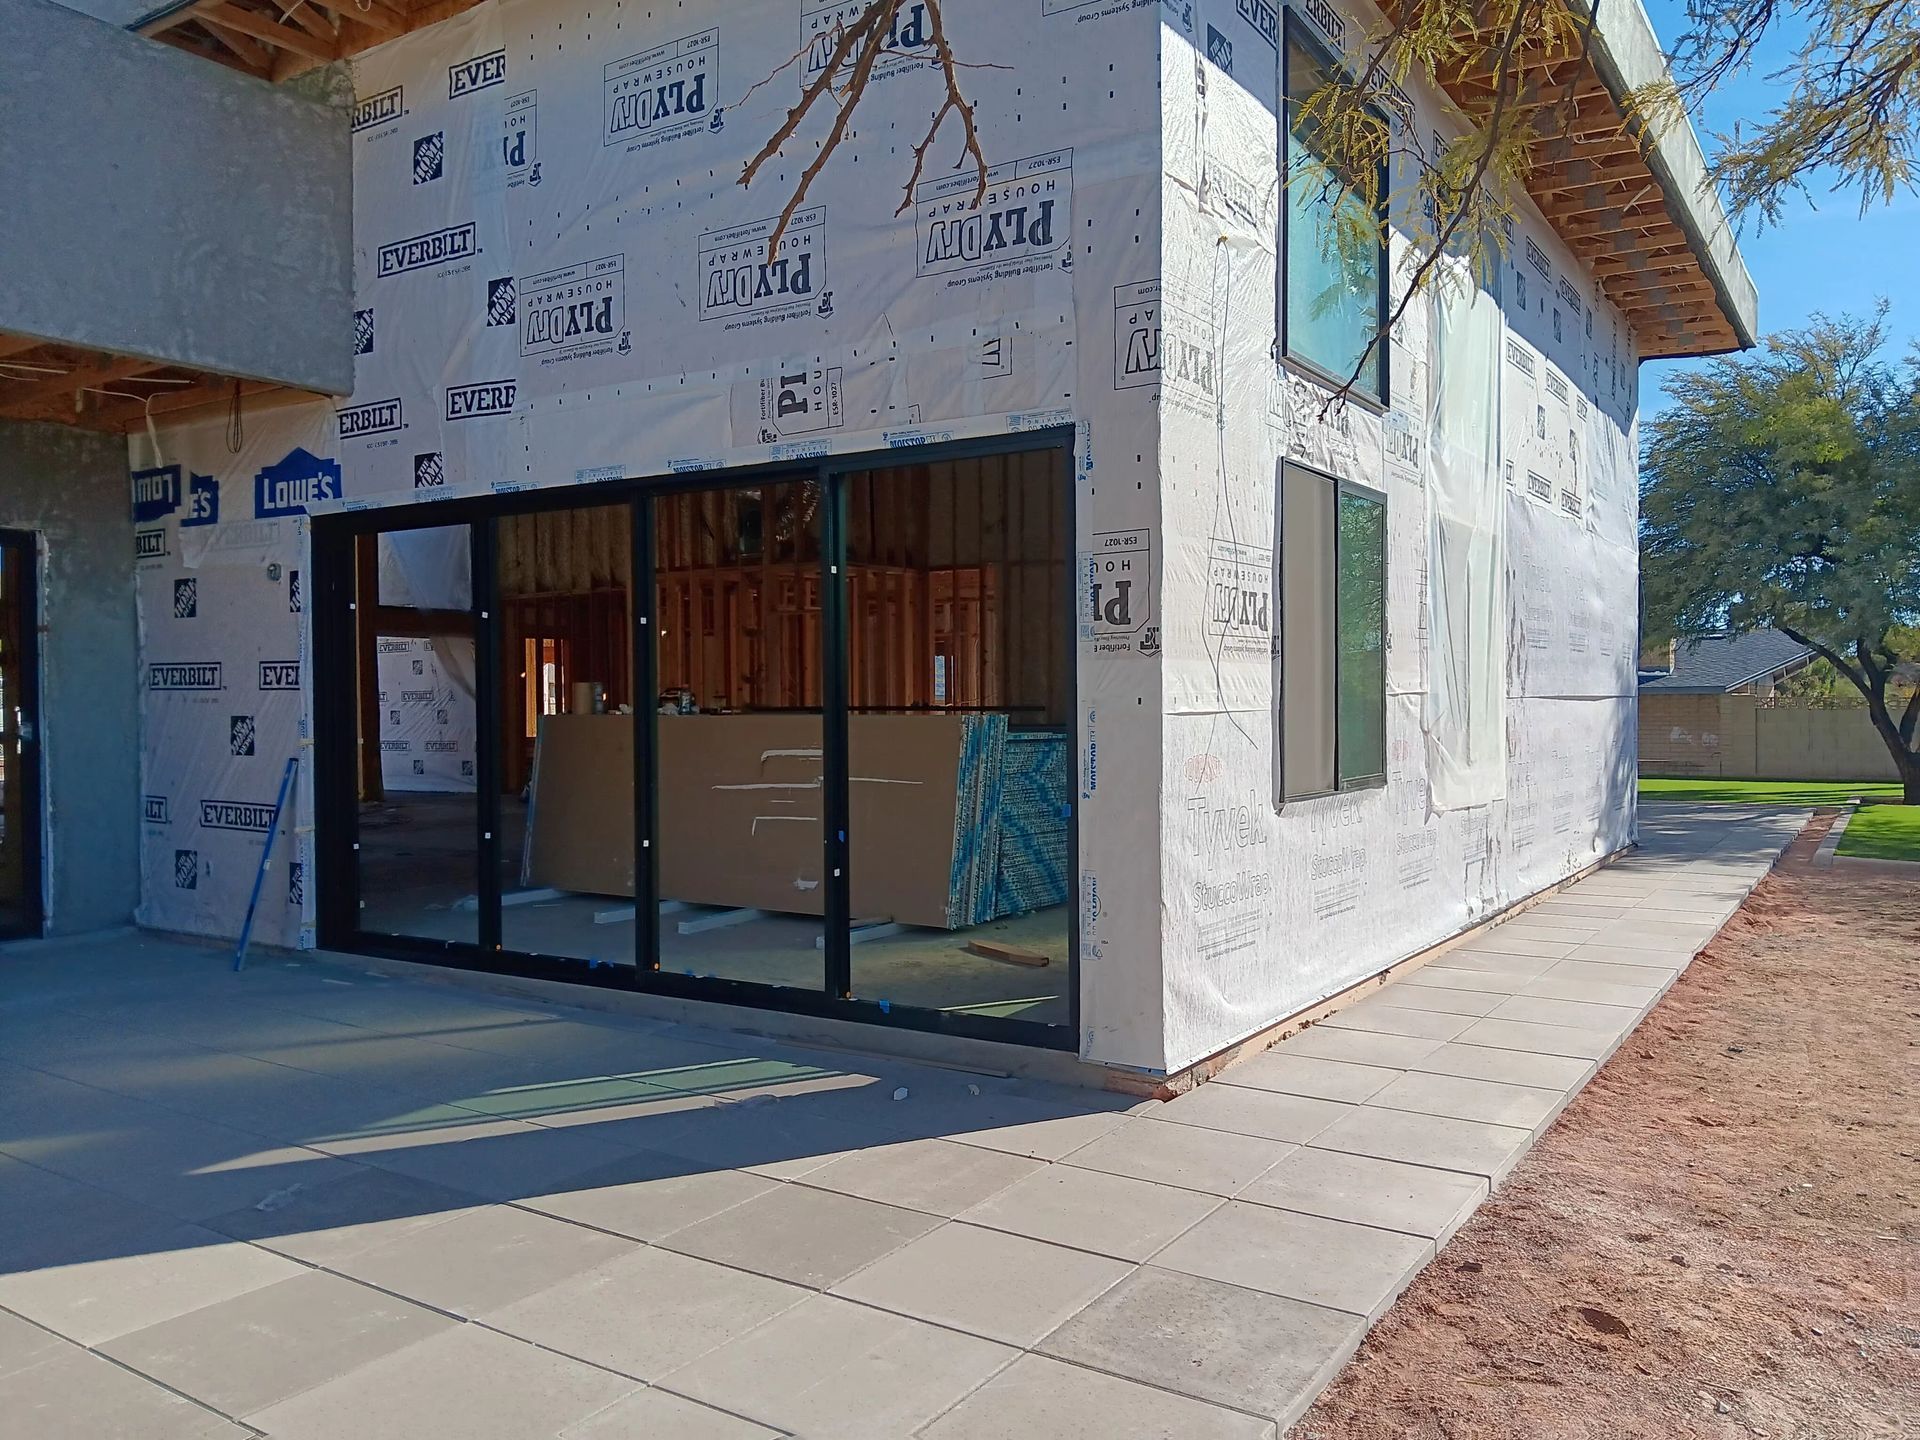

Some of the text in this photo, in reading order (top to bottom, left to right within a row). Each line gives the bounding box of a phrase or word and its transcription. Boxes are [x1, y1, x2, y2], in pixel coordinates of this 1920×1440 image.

[1077, 12, 1099, 24] Group
[1101, 2, 1130, 18] Systems
[871, 62, 924, 82] Fortifiber Building
[611, 73, 705, 133] PLYDry
[1029, 155, 1060, 169] ESR-1027
[926, 200, 1054, 264] PLYDry
[381, 229, 471, 272] EVERBILT
[709, 234, 811, 266] HOUEWRAP
[707, 252, 811, 308] PLYDry
[946, 262, 1054, 289] Fortifiber Building Systems Group
[526, 296, 613, 345] PLYDry
[742, 317, 763, 328] Systems
[763, 313, 785, 324] Building
[787, 309, 811, 319] Fortifiber
[831, 382, 839, 416] ESR-1027
[263, 472, 334, 509] LOWE'S
[1104, 536, 1138, 547] ESR-1027
[152, 666, 218, 686] EVERBILT
[1187, 789, 1264, 871] Tyvek
